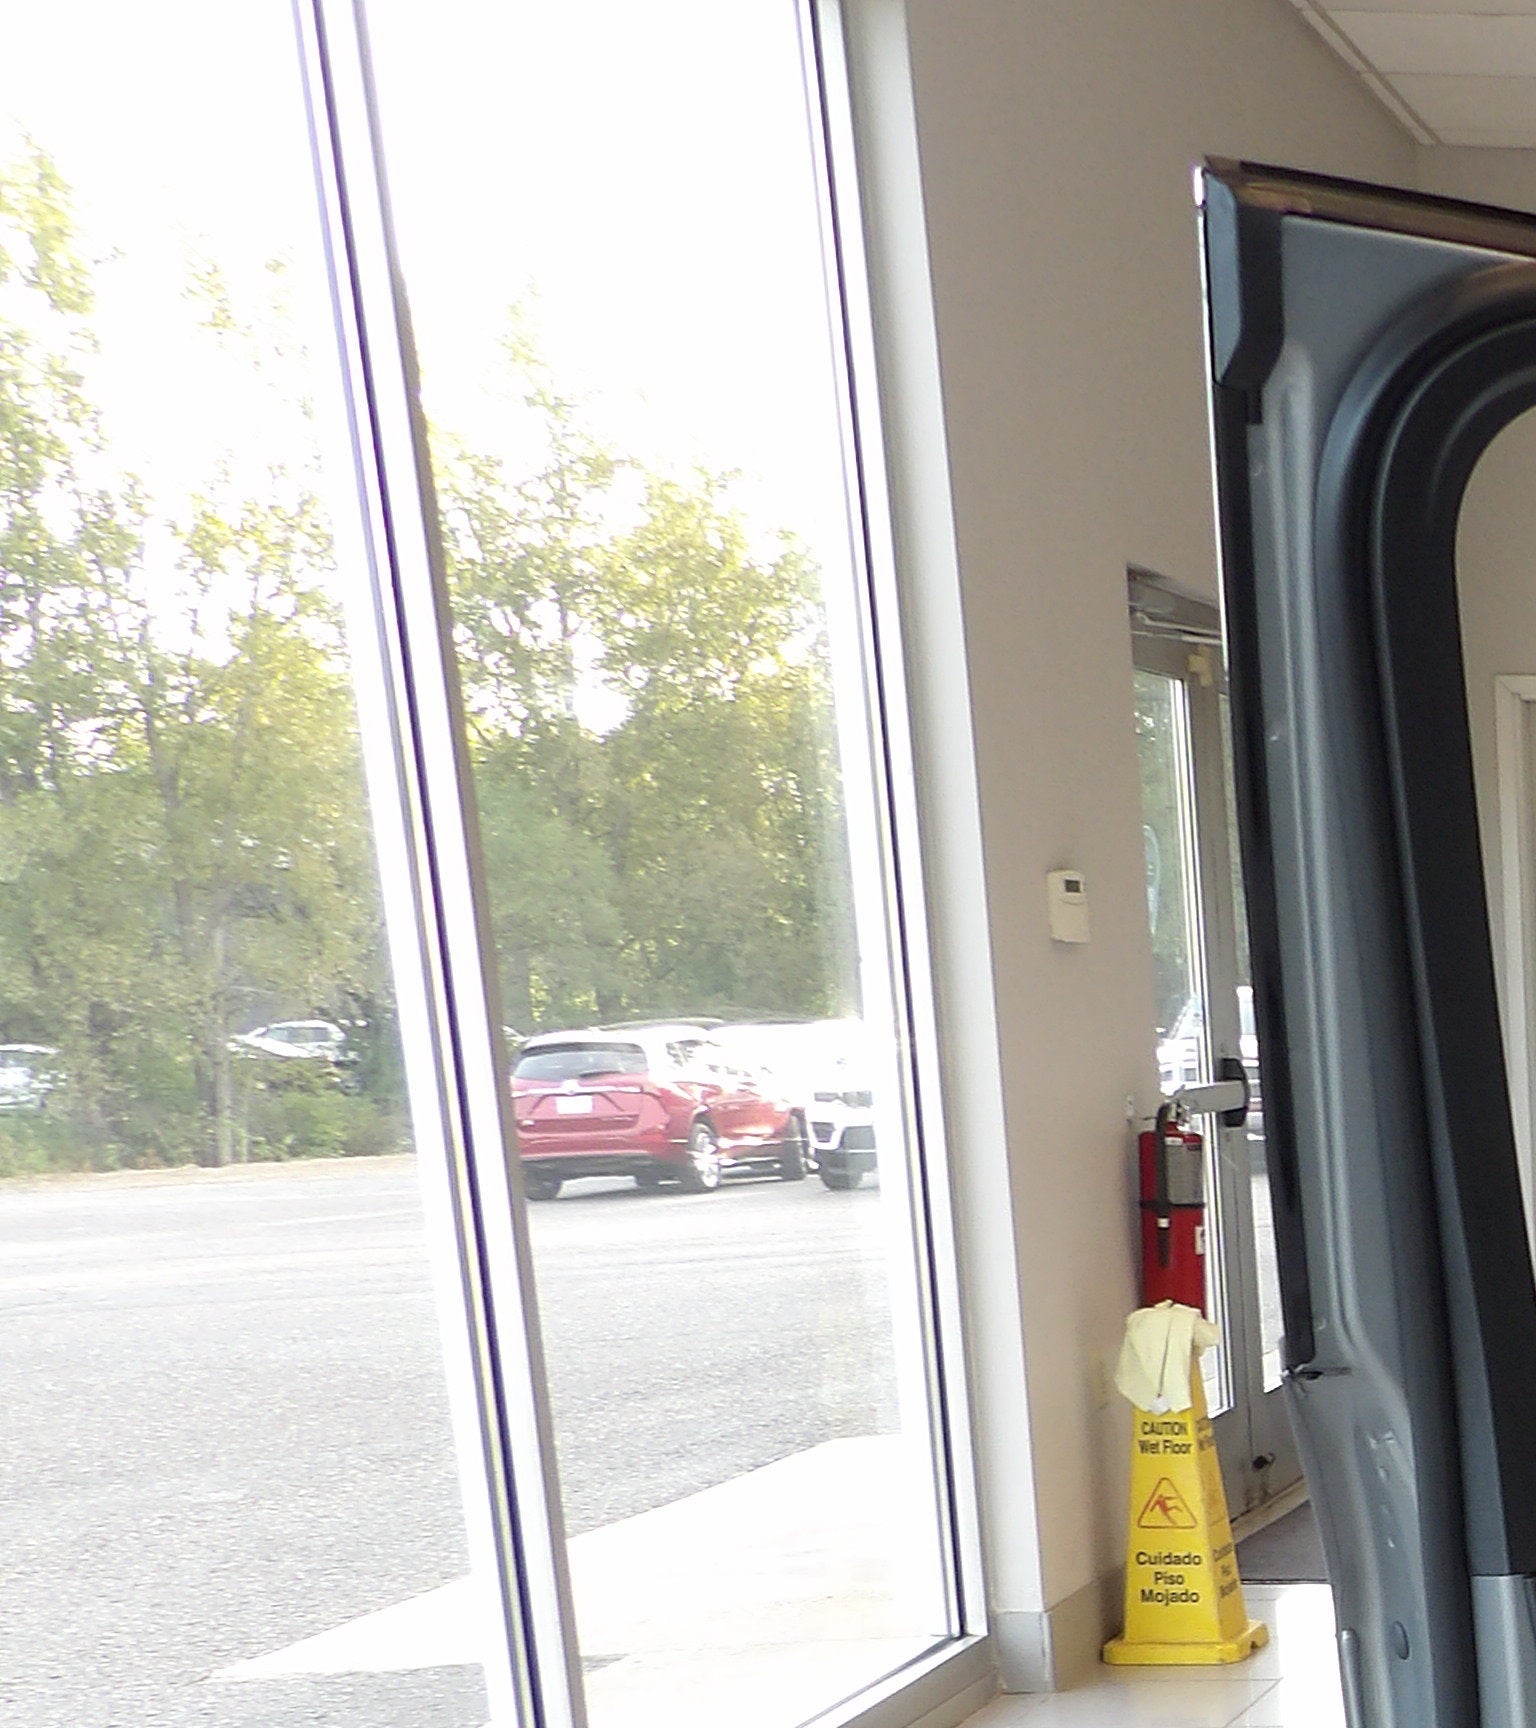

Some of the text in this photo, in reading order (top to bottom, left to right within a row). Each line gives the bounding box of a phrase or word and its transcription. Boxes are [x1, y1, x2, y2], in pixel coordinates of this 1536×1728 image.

[1141, 1421, 1188, 1436] CAUTION
[1139, 1440, 1160, 1455] Wet
[1163, 1440, 1192, 1455] Floor
[1136, 1551, 1202, 1566] Cuidado
[1154, 1571, 1185, 1585] Piso
[1141, 1588, 1200, 1605] Mojado
